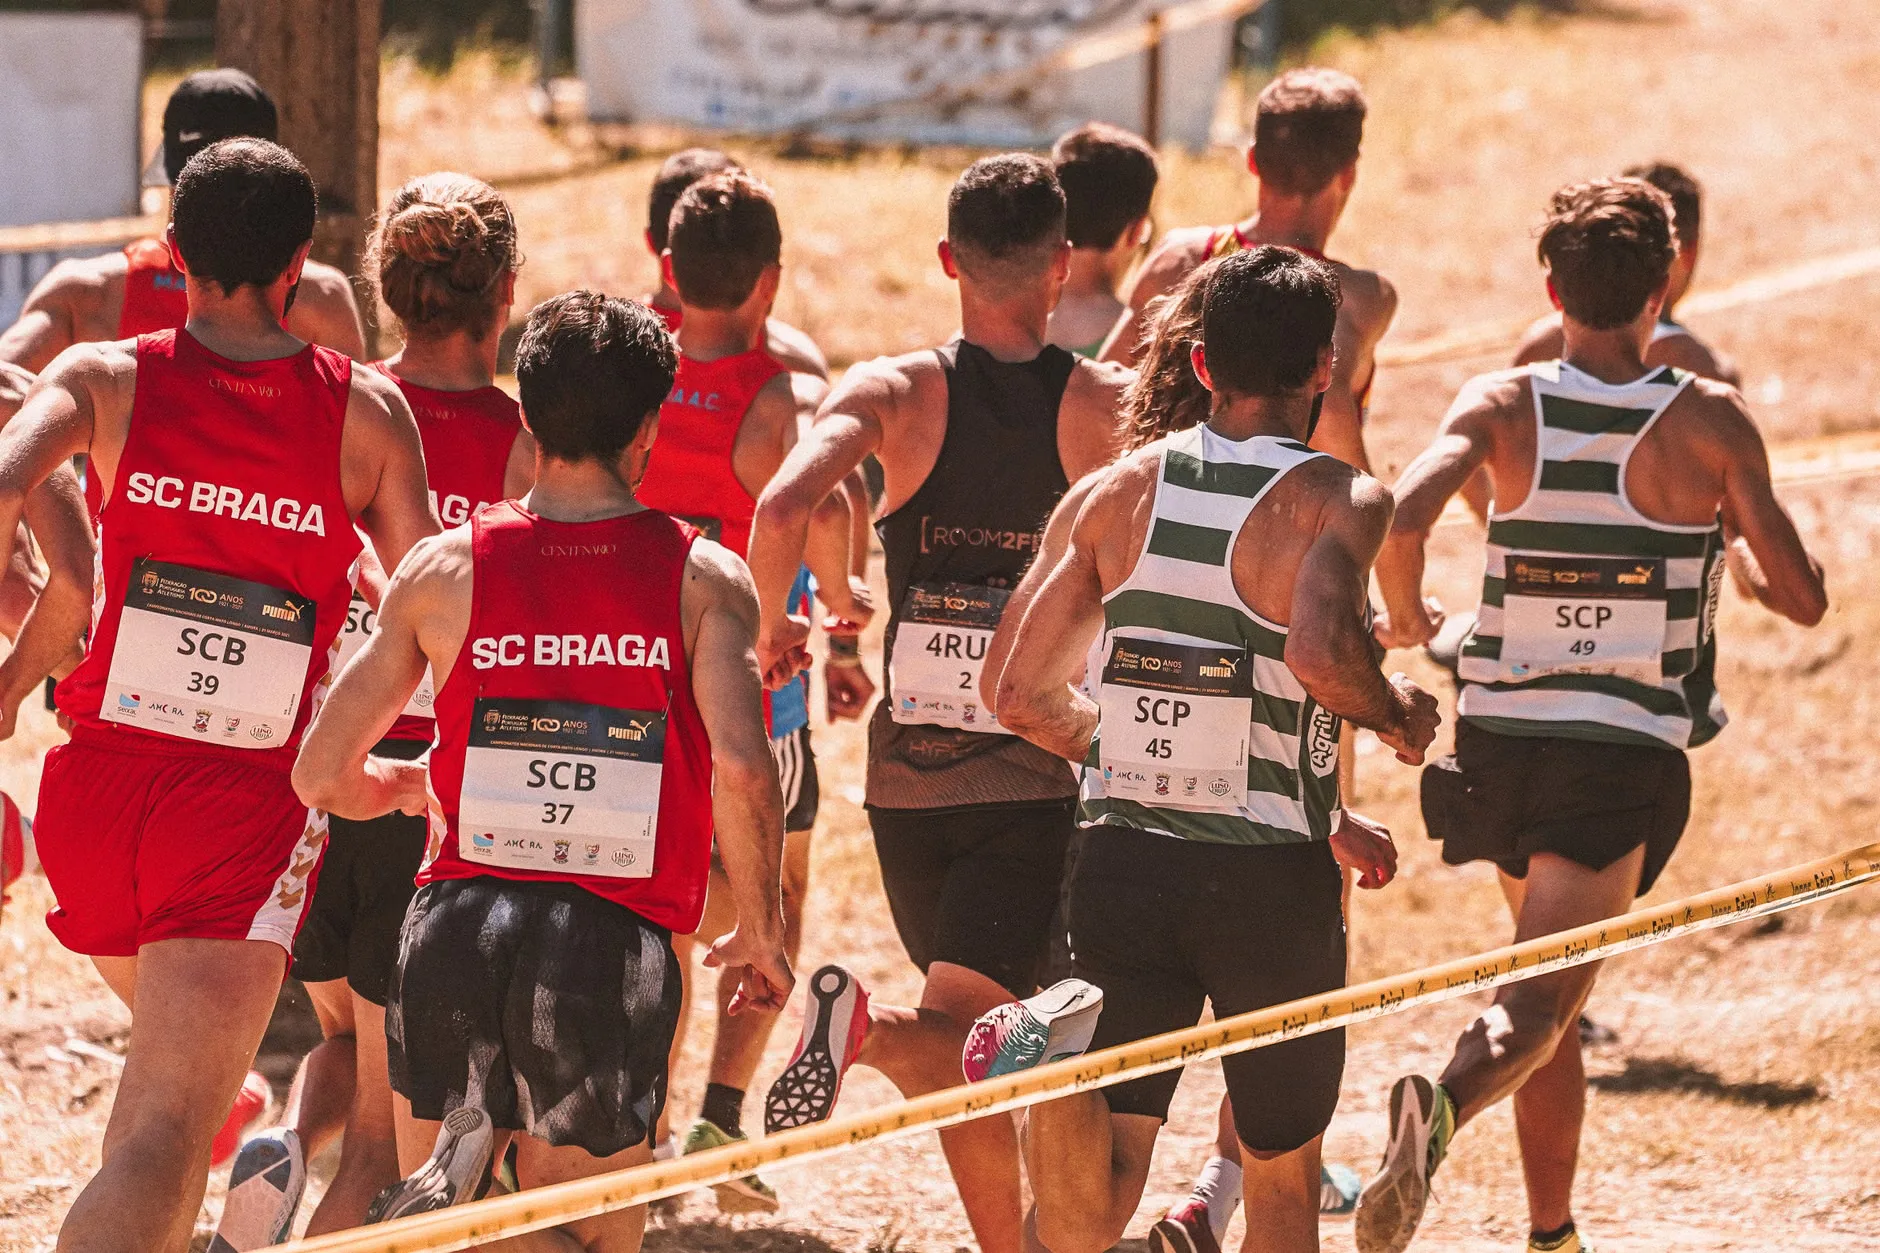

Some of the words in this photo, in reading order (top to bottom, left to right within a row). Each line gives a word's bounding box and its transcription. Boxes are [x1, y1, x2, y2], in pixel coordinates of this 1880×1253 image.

[127, 472, 184, 509] SC
[189, 481, 325, 537] BRAGA
[189, 588, 217, 604] 100
[220, 594, 244, 605] ANOS
[262, 604, 295, 622] PUMA
[1556, 605, 1612, 629] SCP
[176, 627, 247, 666] SCB
[472, 634, 526, 670] SC
[533, 633, 671, 671] BRAGA
[1569, 640, 1596, 655] 49
[1140, 656, 1161, 671] 100
[1162, 659, 1182, 669] ANOS
[1199, 665, 1231, 678] PUMA
[187, 672, 219, 696] 39
[959, 672, 972, 689] 2
[1134, 696, 1191, 727] SCP
[531, 718, 560, 733] 100
[562, 720, 588, 729] ANOS
[608, 726, 641, 741] PUMA
[1145, 738, 1172, 759] 45
[526, 759, 596, 791] SCB
[541, 802, 574, 825] 37
